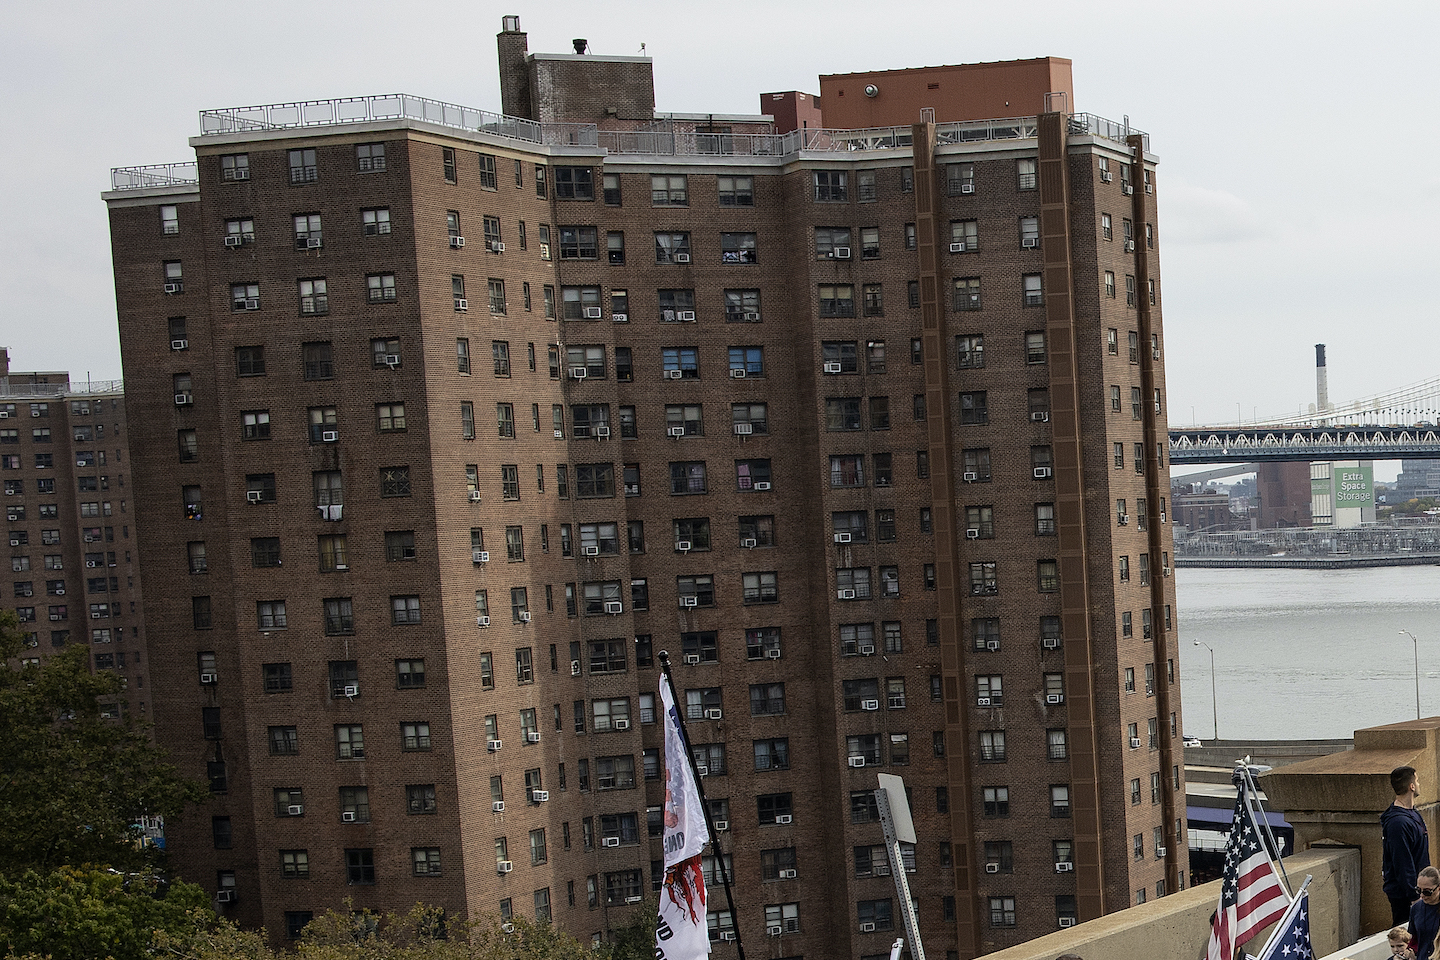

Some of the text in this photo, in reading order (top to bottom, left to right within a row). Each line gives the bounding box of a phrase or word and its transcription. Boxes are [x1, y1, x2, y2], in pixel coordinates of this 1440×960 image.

[1342, 472, 1364, 481] Extra
[1341, 481, 1366, 492] Space
[1337, 491, 1371, 502] Storage
